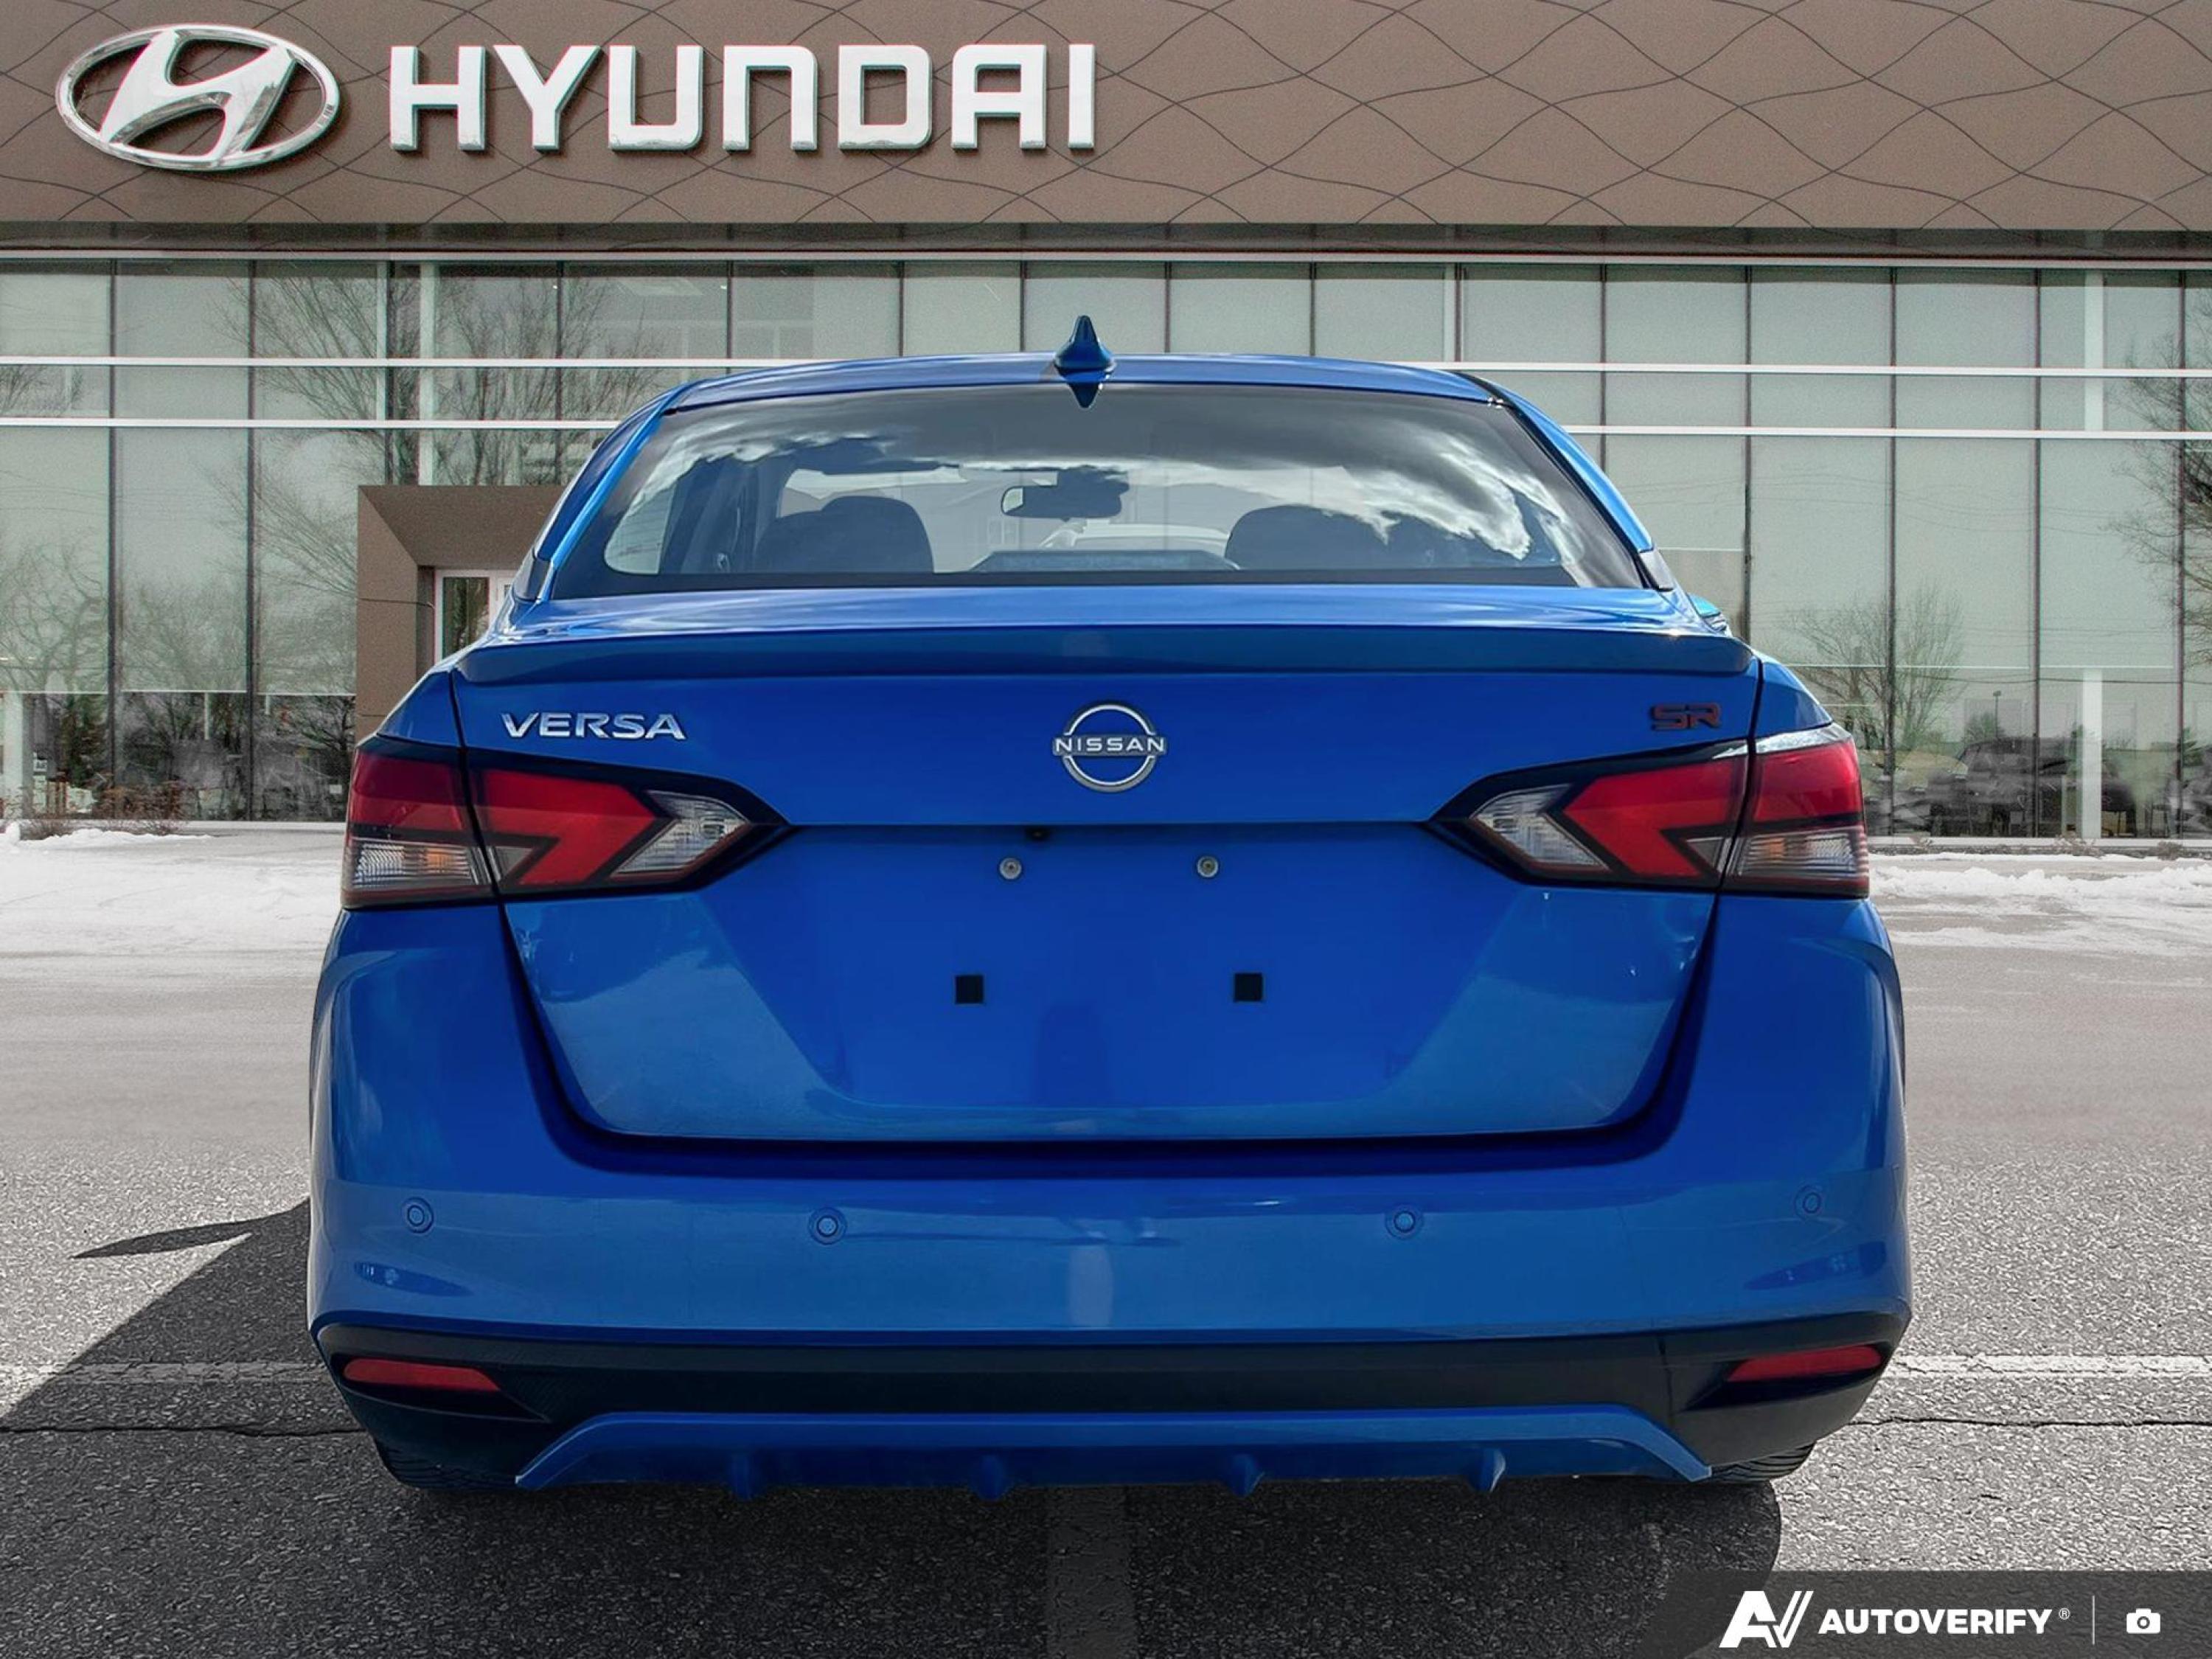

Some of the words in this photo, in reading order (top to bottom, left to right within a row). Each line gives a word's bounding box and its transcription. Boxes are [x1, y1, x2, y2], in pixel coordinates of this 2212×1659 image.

[389, 44, 1095, 150] HYUNDAI
[501, 712, 686, 740] VERSA
[1651, 703, 1721, 730] SR
[1055, 737, 1164, 752] NISSAN
